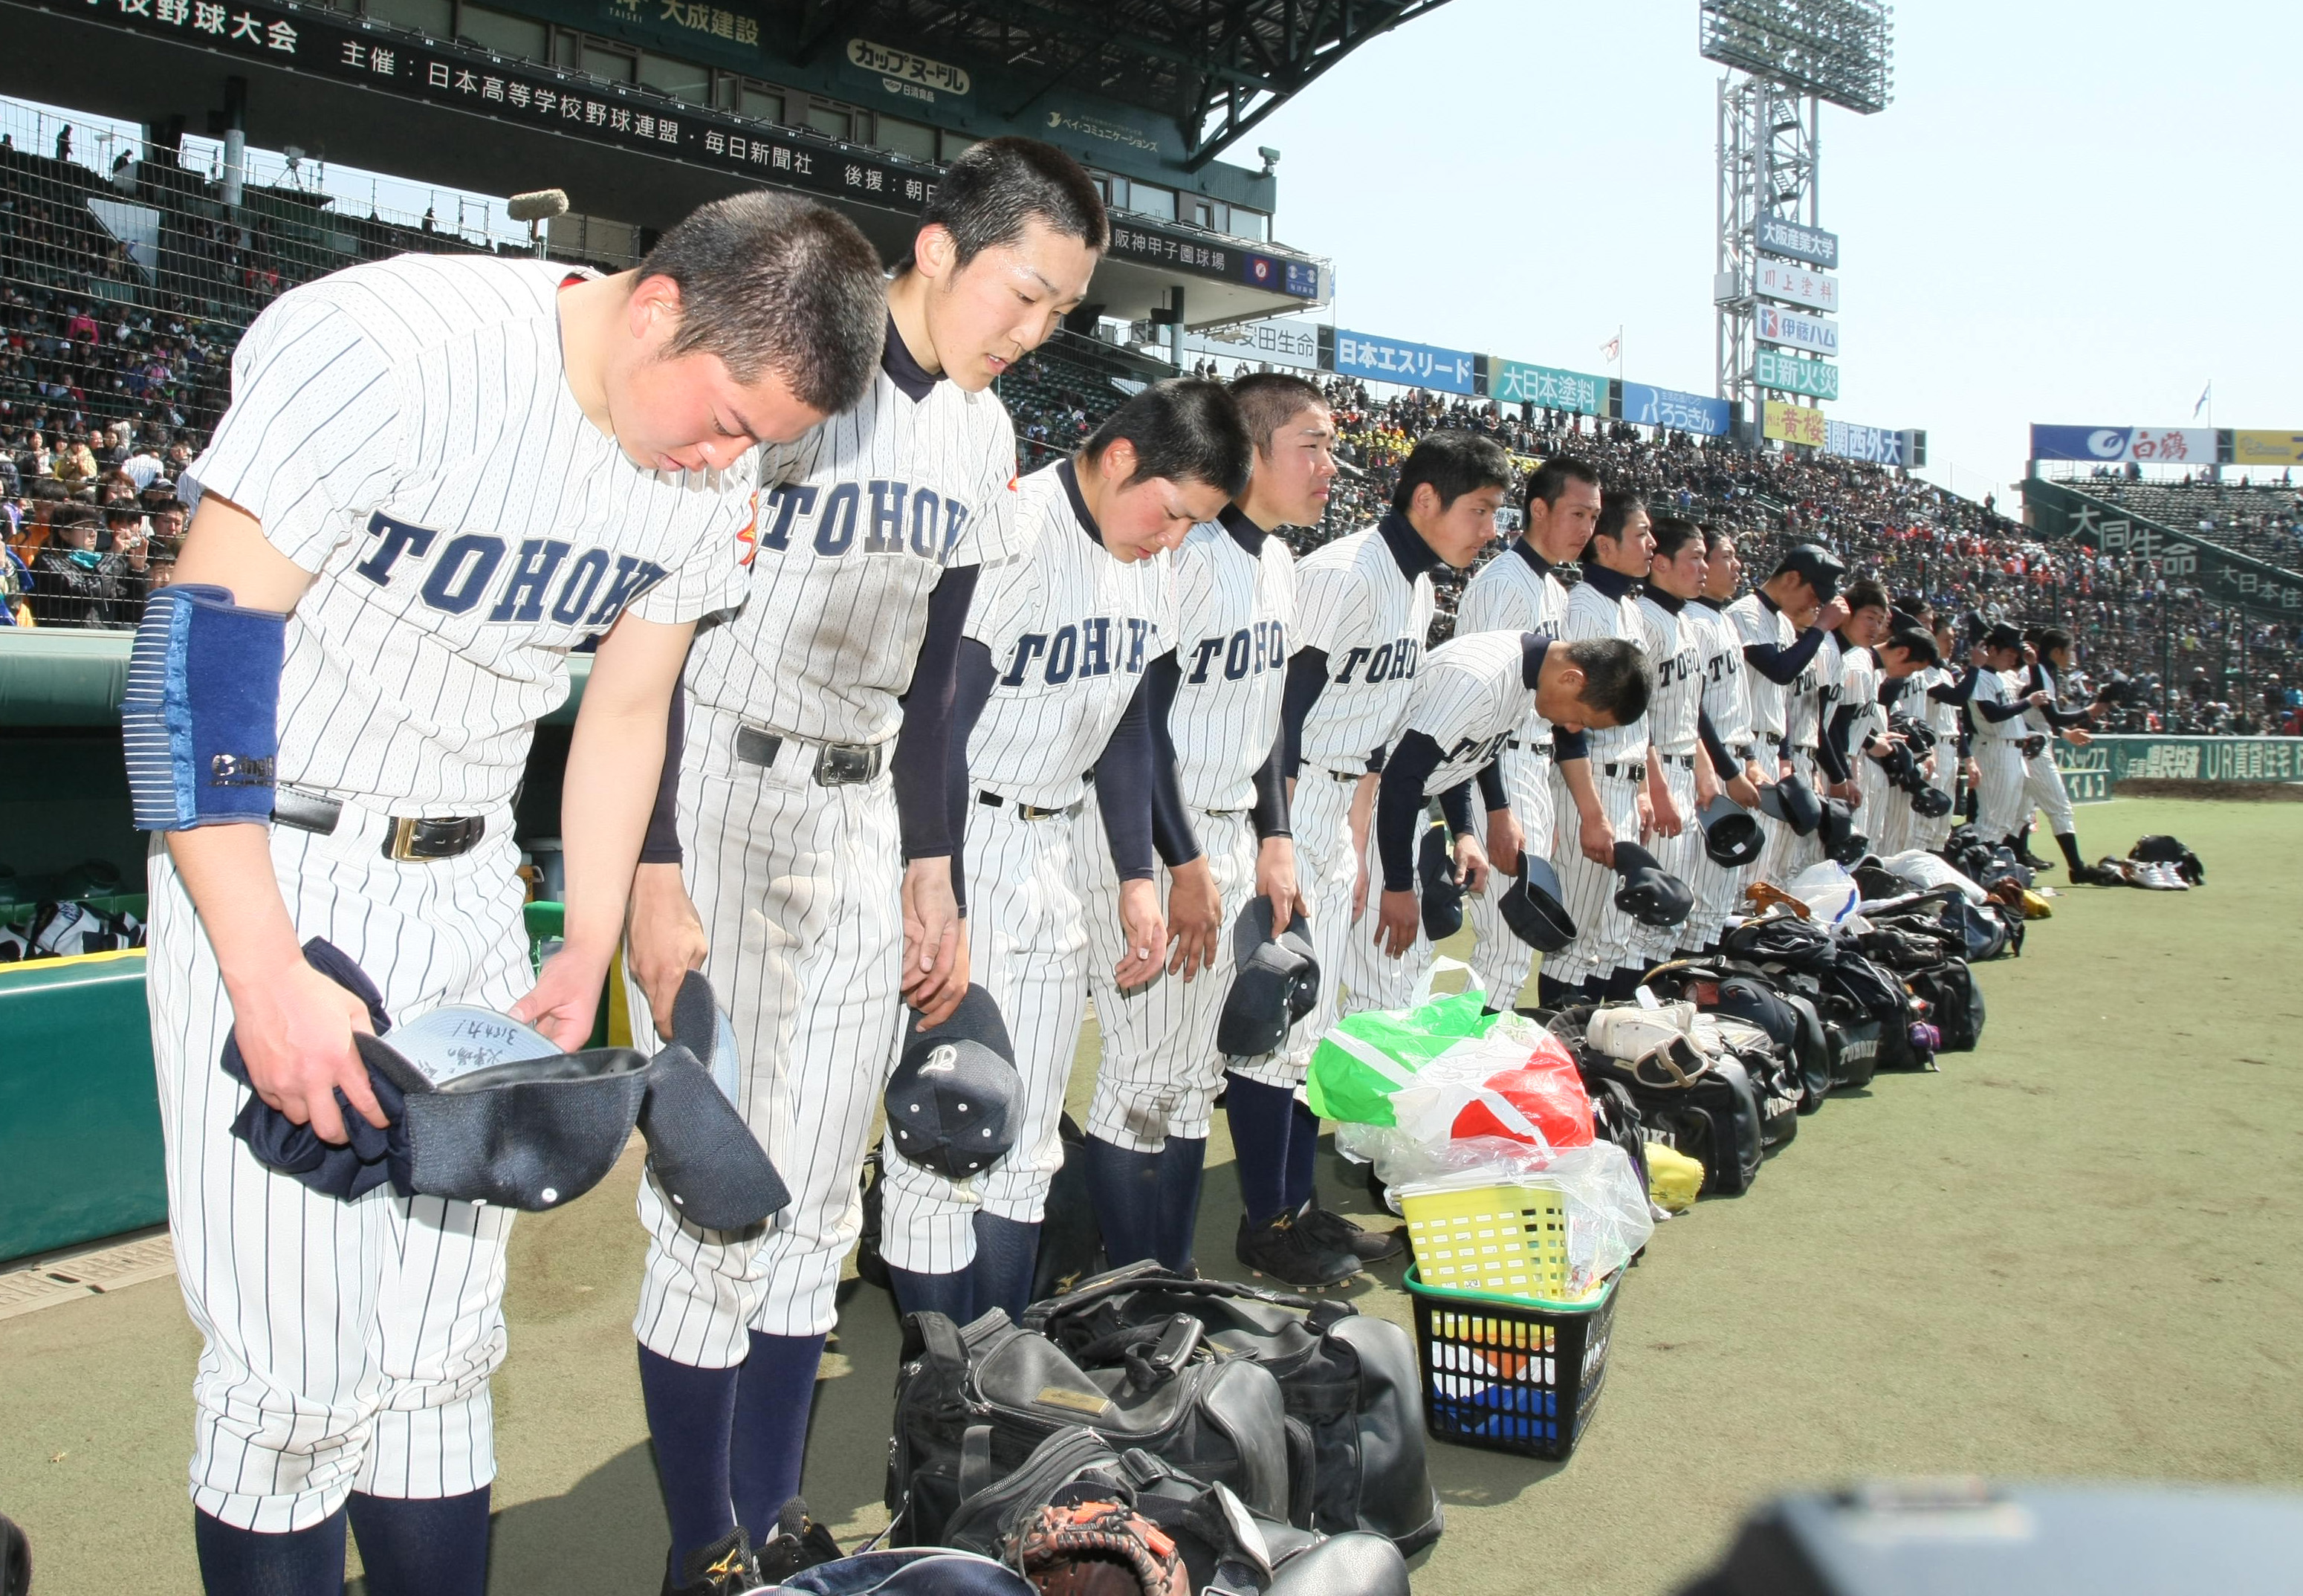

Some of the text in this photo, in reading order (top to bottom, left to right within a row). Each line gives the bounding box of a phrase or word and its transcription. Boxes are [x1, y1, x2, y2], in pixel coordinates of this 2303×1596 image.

[660, 0, 759, 46] 大成建設
[855, 42, 964, 91] カップヌードル
[903, 84, 935, 103] 日清食品
[1115, 228, 1225, 271] 阪神甲子園球場
[1762, 221, 1835, 259] 大阪産業大学
[1763, 268, 1833, 302] 川上塗料
[1781, 317, 1837, 348] 伊藤ハム
[1338, 337, 1471, 385] 日本エスリード
[1758, 353, 1838, 396] 日新火災
[1503, 366, 1596, 412] 大日本塗料
[1660, 402, 1715, 432] ろうきん
[2132, 431, 2188, 460] 白鶴
[2069, 505, 2197, 577] 大同生命
